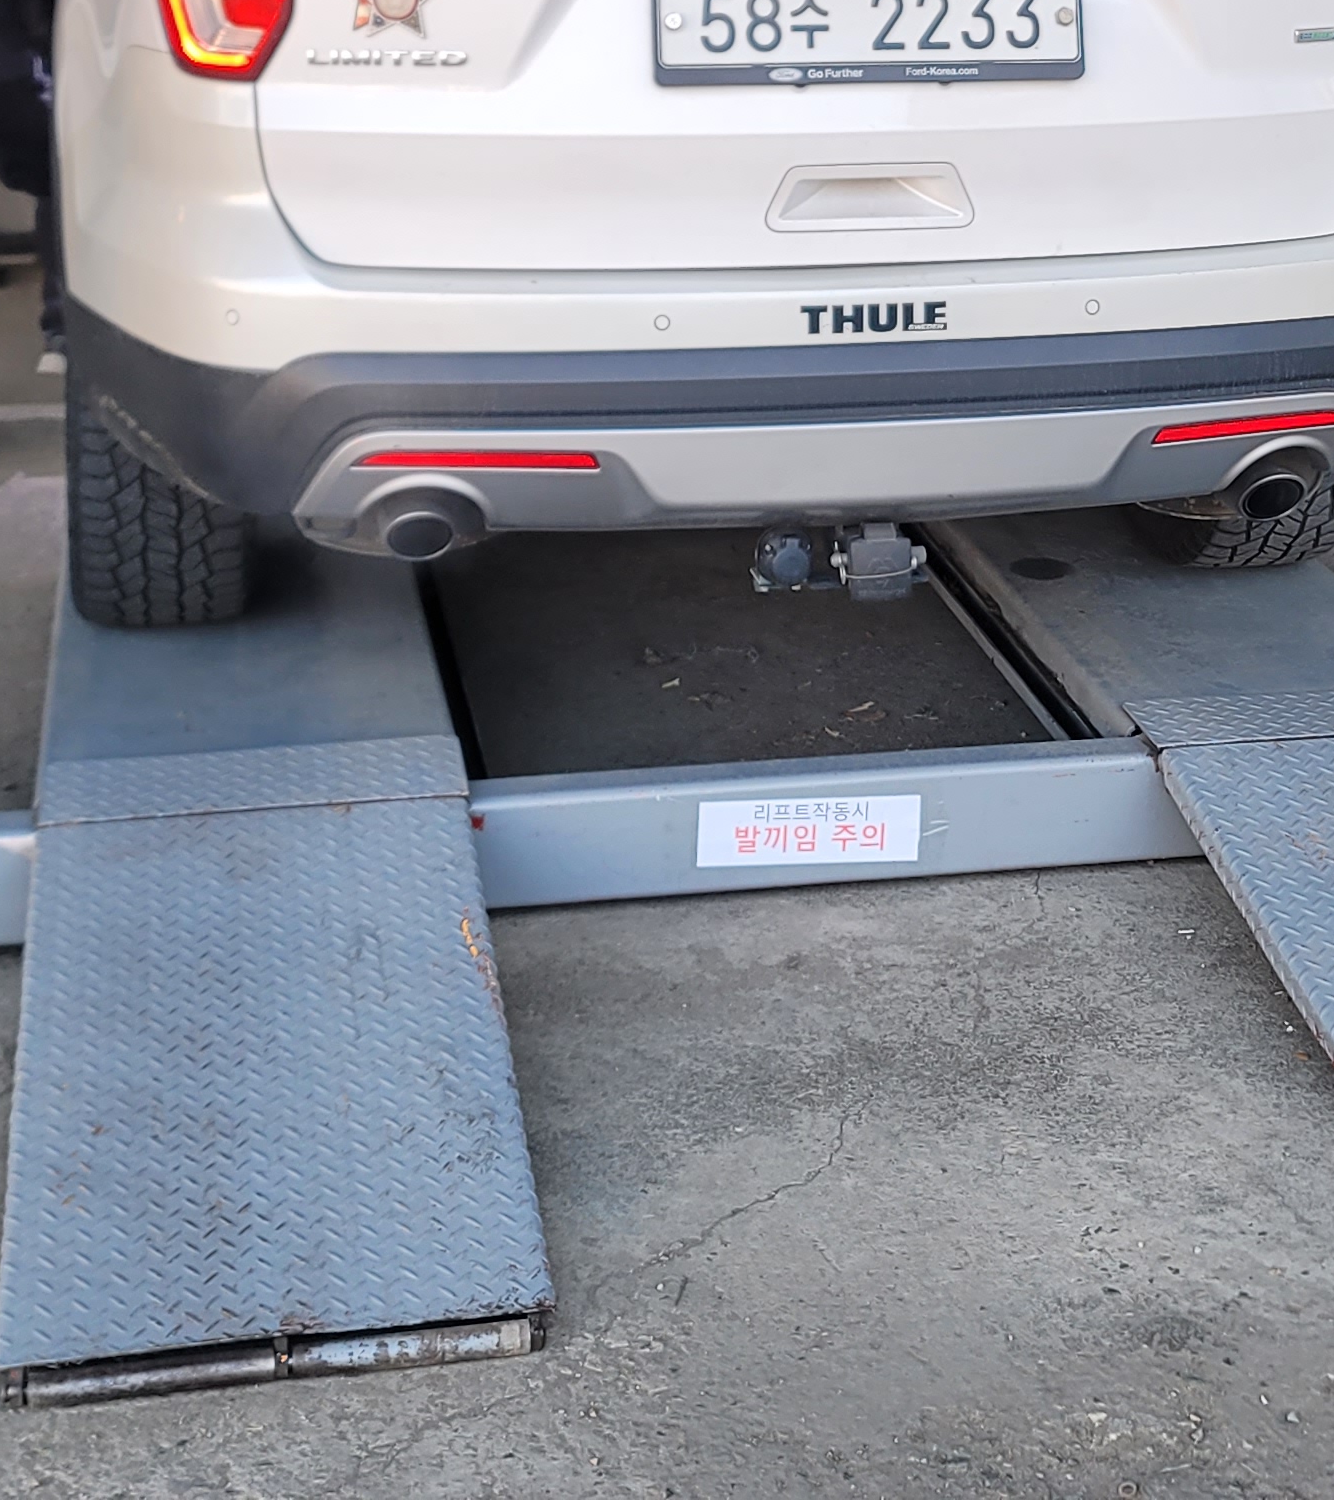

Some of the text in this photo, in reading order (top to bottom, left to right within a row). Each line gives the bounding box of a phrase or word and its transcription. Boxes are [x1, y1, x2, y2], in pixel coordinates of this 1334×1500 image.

[305, 48, 469, 67] LIMITED
[807, 67, 864, 79] Go Further
[905, 67, 979, 77] Ford-Korea.com
[800, 301, 947, 334] THULE
[754, 801, 870, 824] 리프트작동시
[734, 822, 886, 853] 발끼임 주의
